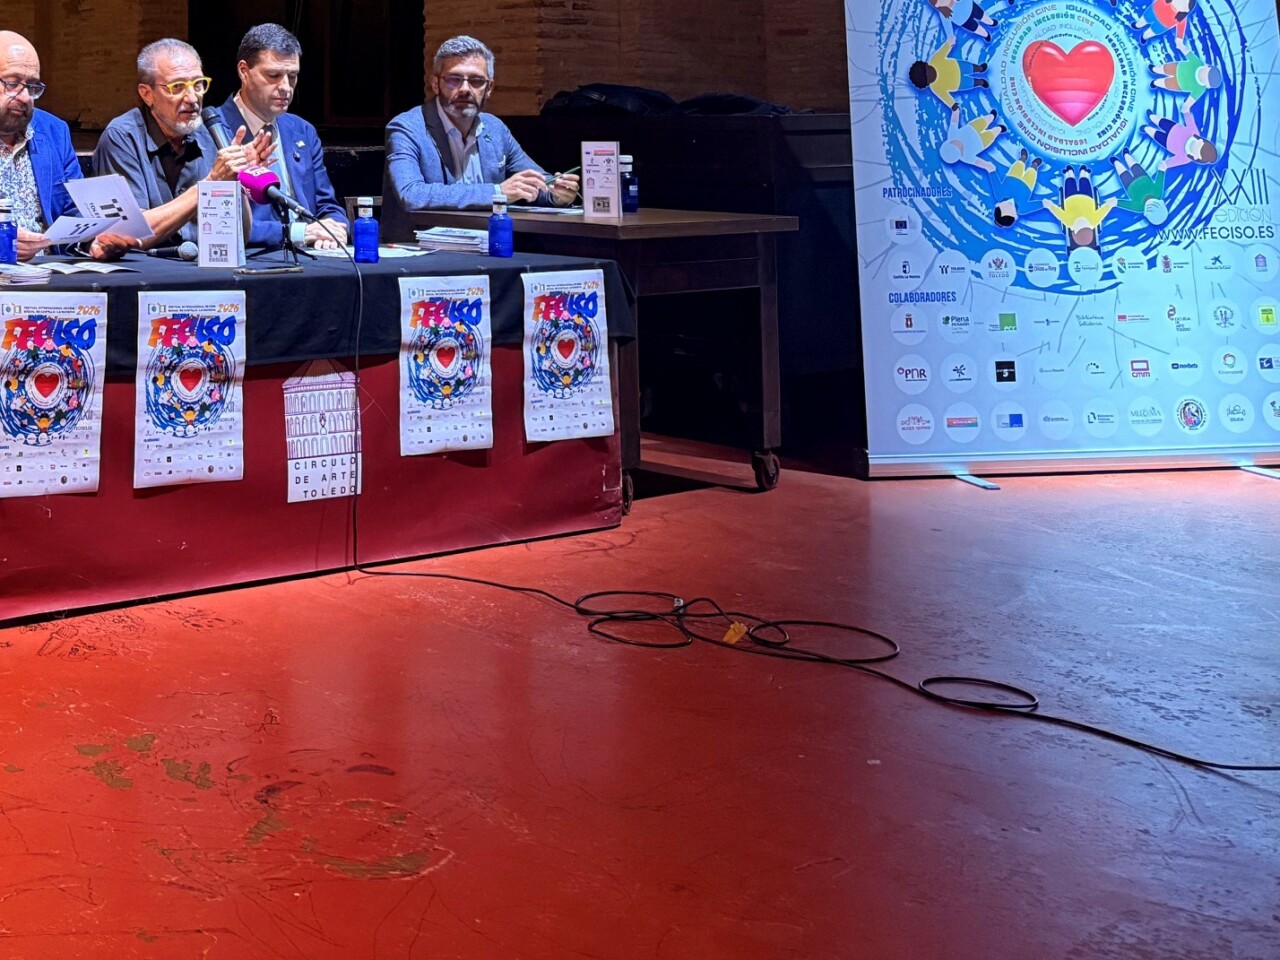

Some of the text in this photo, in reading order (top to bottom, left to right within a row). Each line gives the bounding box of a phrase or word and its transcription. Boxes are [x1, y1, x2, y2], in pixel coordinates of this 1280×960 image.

[1065, 4, 1137, 113] IGUALDAD INCLUSIÓN CINE
[1016, 118, 1129, 156] IGUALDAD INCLUSIÓN CINE
[883, 187, 953, 199] PATROCINADORES
[1212, 168, 1269, 206] XXIII
[1157, 226, 1275, 241] WWW.FECISO.ES
[888, 291, 957, 304] COLABORADORES
[76, 305, 101, 316] 2026
[217, 303, 240, 313] 2026
[409, 297, 483, 329] FECISO
[532, 290, 598, 322] FECISO
[950, 315, 970, 323] Plena
[1, 317, 97, 351] FECISO
[148, 315, 237, 348] FECISO
[294, 456, 357, 471] CIRCULO
[295, 470, 356, 485] DE ARTE
[303, 485, 356, 499] TOLEDO
